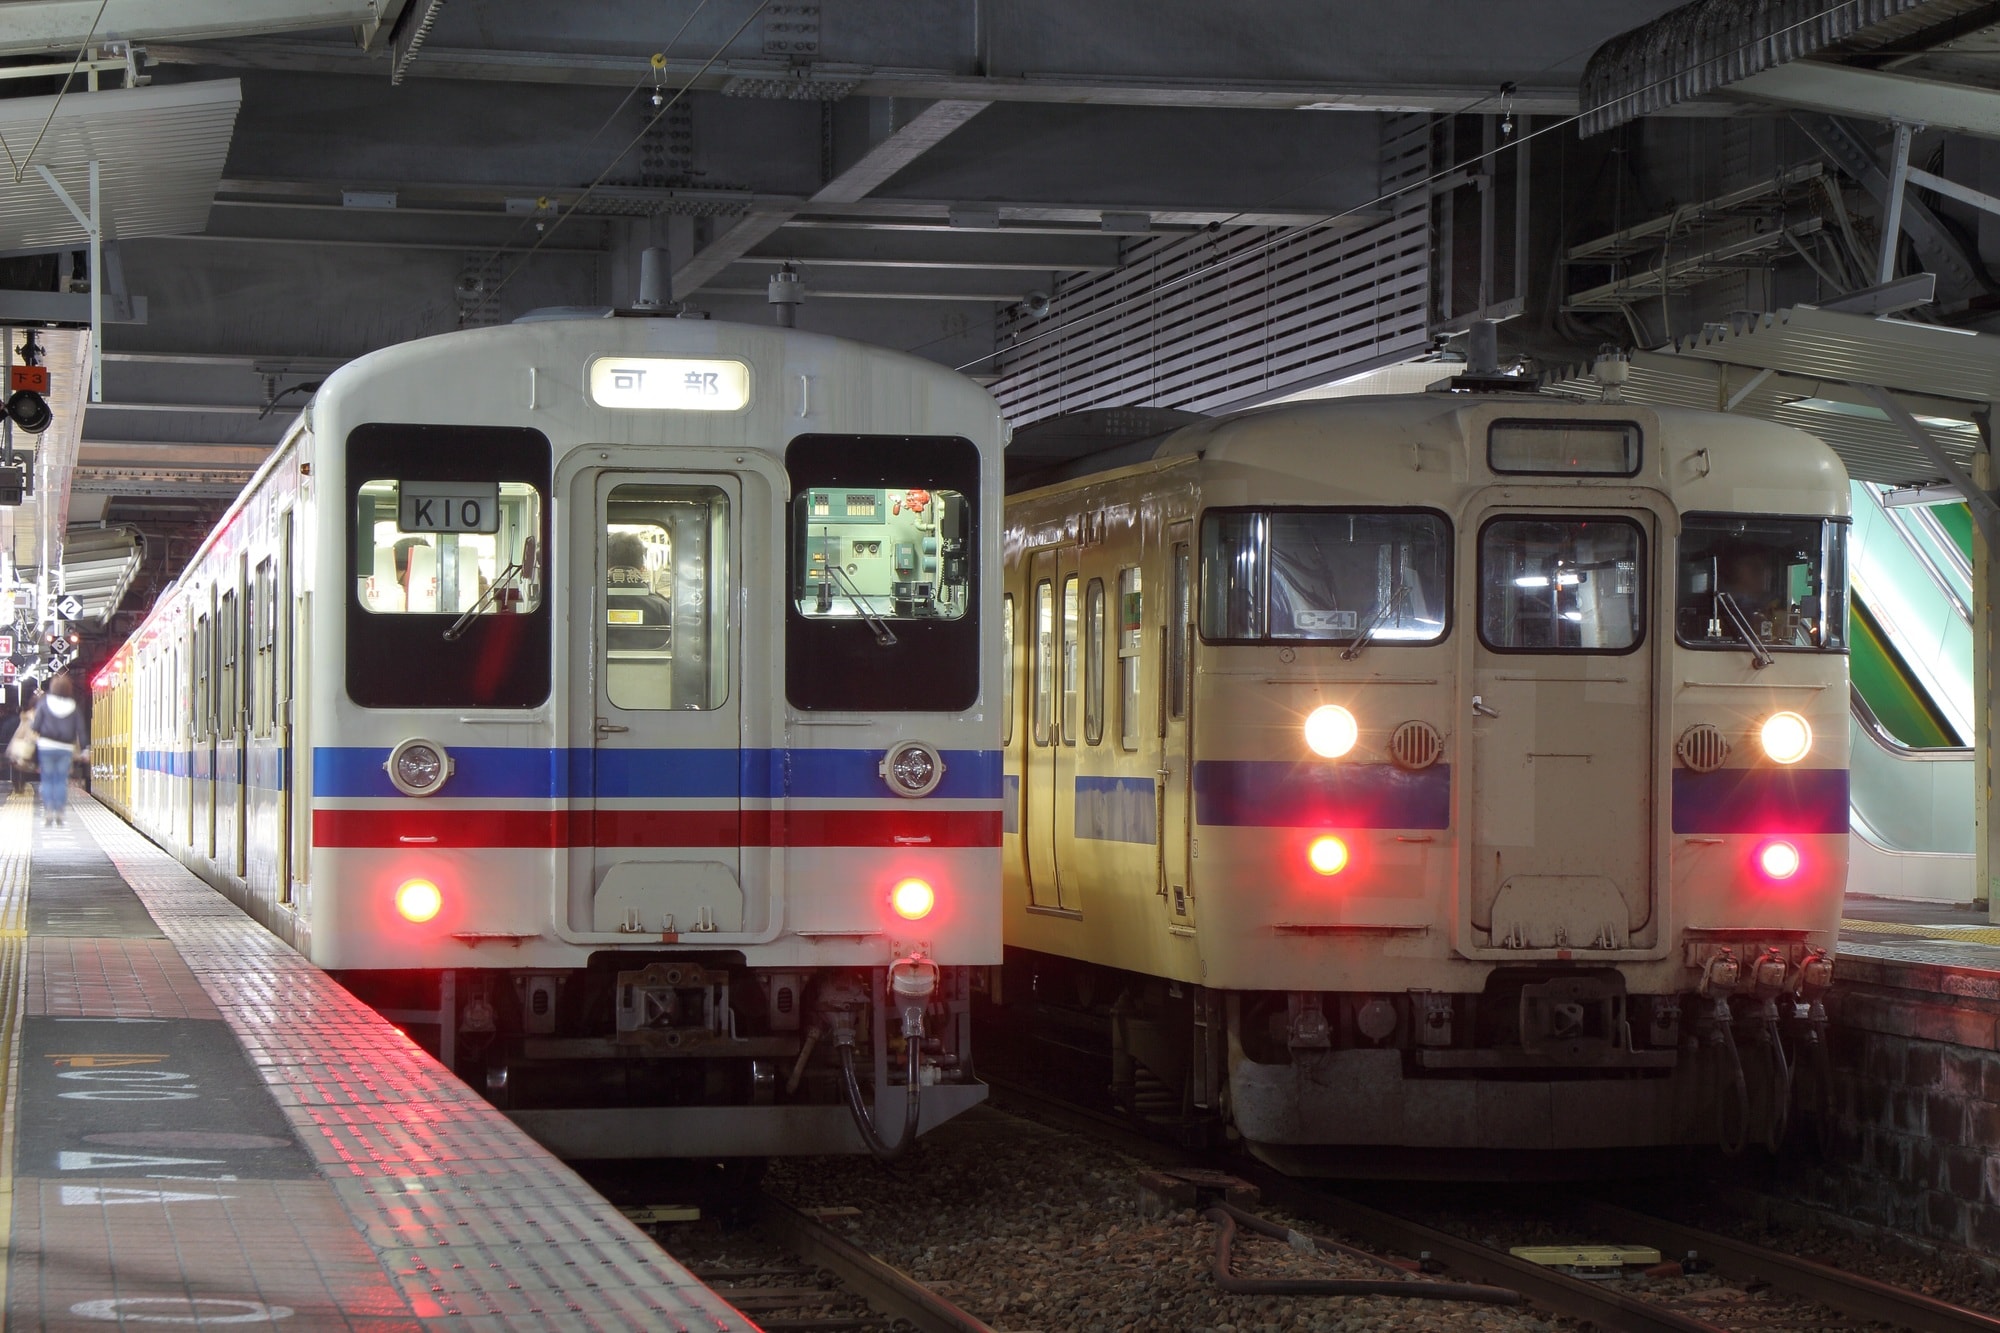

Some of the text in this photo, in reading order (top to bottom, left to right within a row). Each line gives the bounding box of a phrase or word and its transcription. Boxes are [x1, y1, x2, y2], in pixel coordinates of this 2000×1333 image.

[610, 368, 719, 396] 可部
[415, 499, 480, 528] K10
[65, 601, 75, 614] 2
[1296, 611, 1355, 628] C-41
[57, 640, 64, 650] 3
[53, 661, 59, 669] 4
